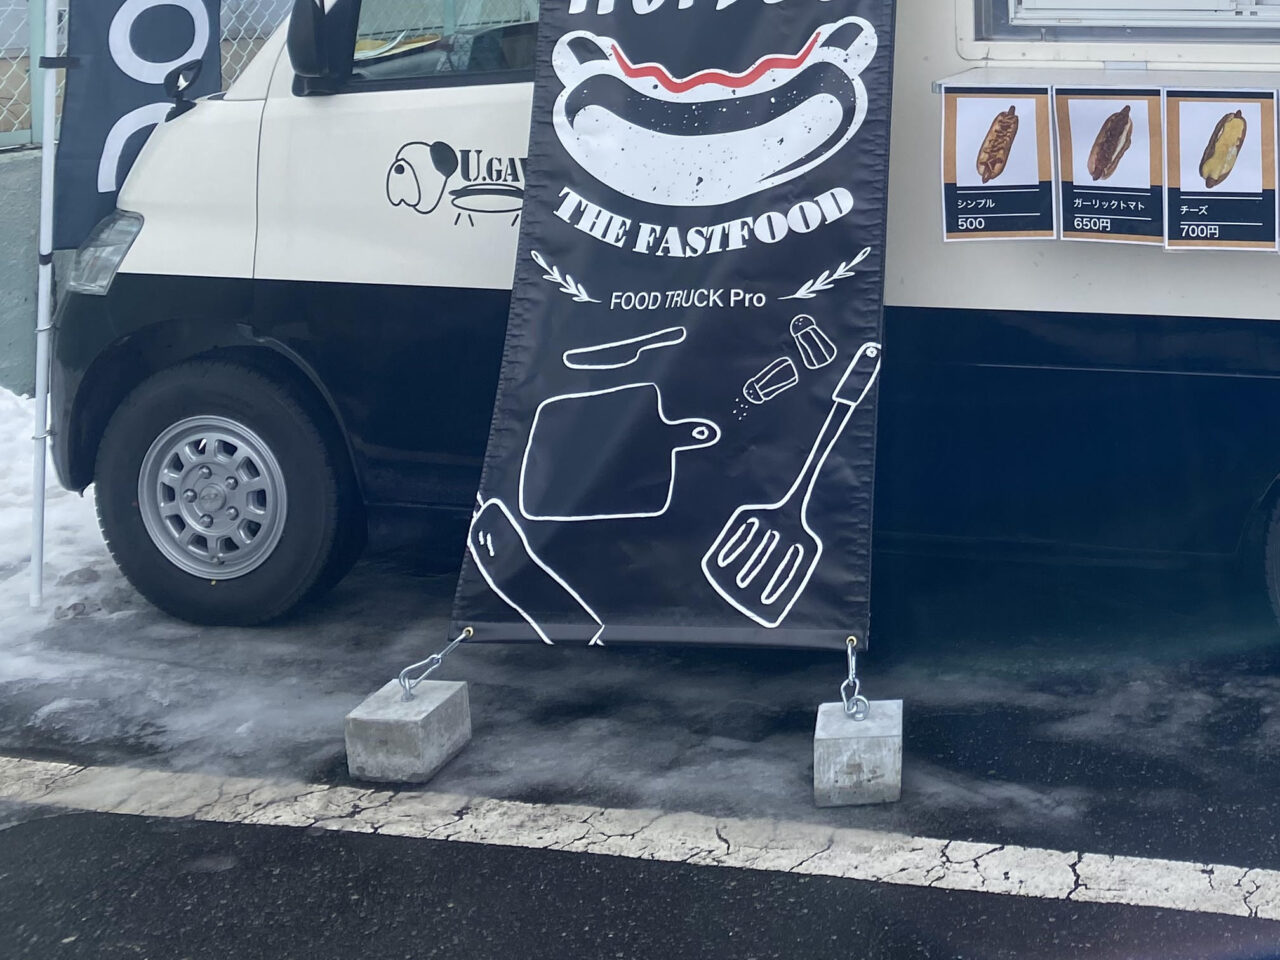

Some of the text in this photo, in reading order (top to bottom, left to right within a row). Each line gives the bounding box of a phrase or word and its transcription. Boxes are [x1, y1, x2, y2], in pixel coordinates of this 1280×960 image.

[956, 198, 996, 210] シンプル
[1073, 198, 1146, 211] ガーリックトマト
[1179, 205, 1209, 216] チーズ
[552, 186, 630, 250] THE
[957, 218, 985, 230] 500
[1073, 217, 1111, 231] 650円
[1179, 225, 1219, 238] 700円
[610, 288, 767, 311] FOOD TRUCK Pro
